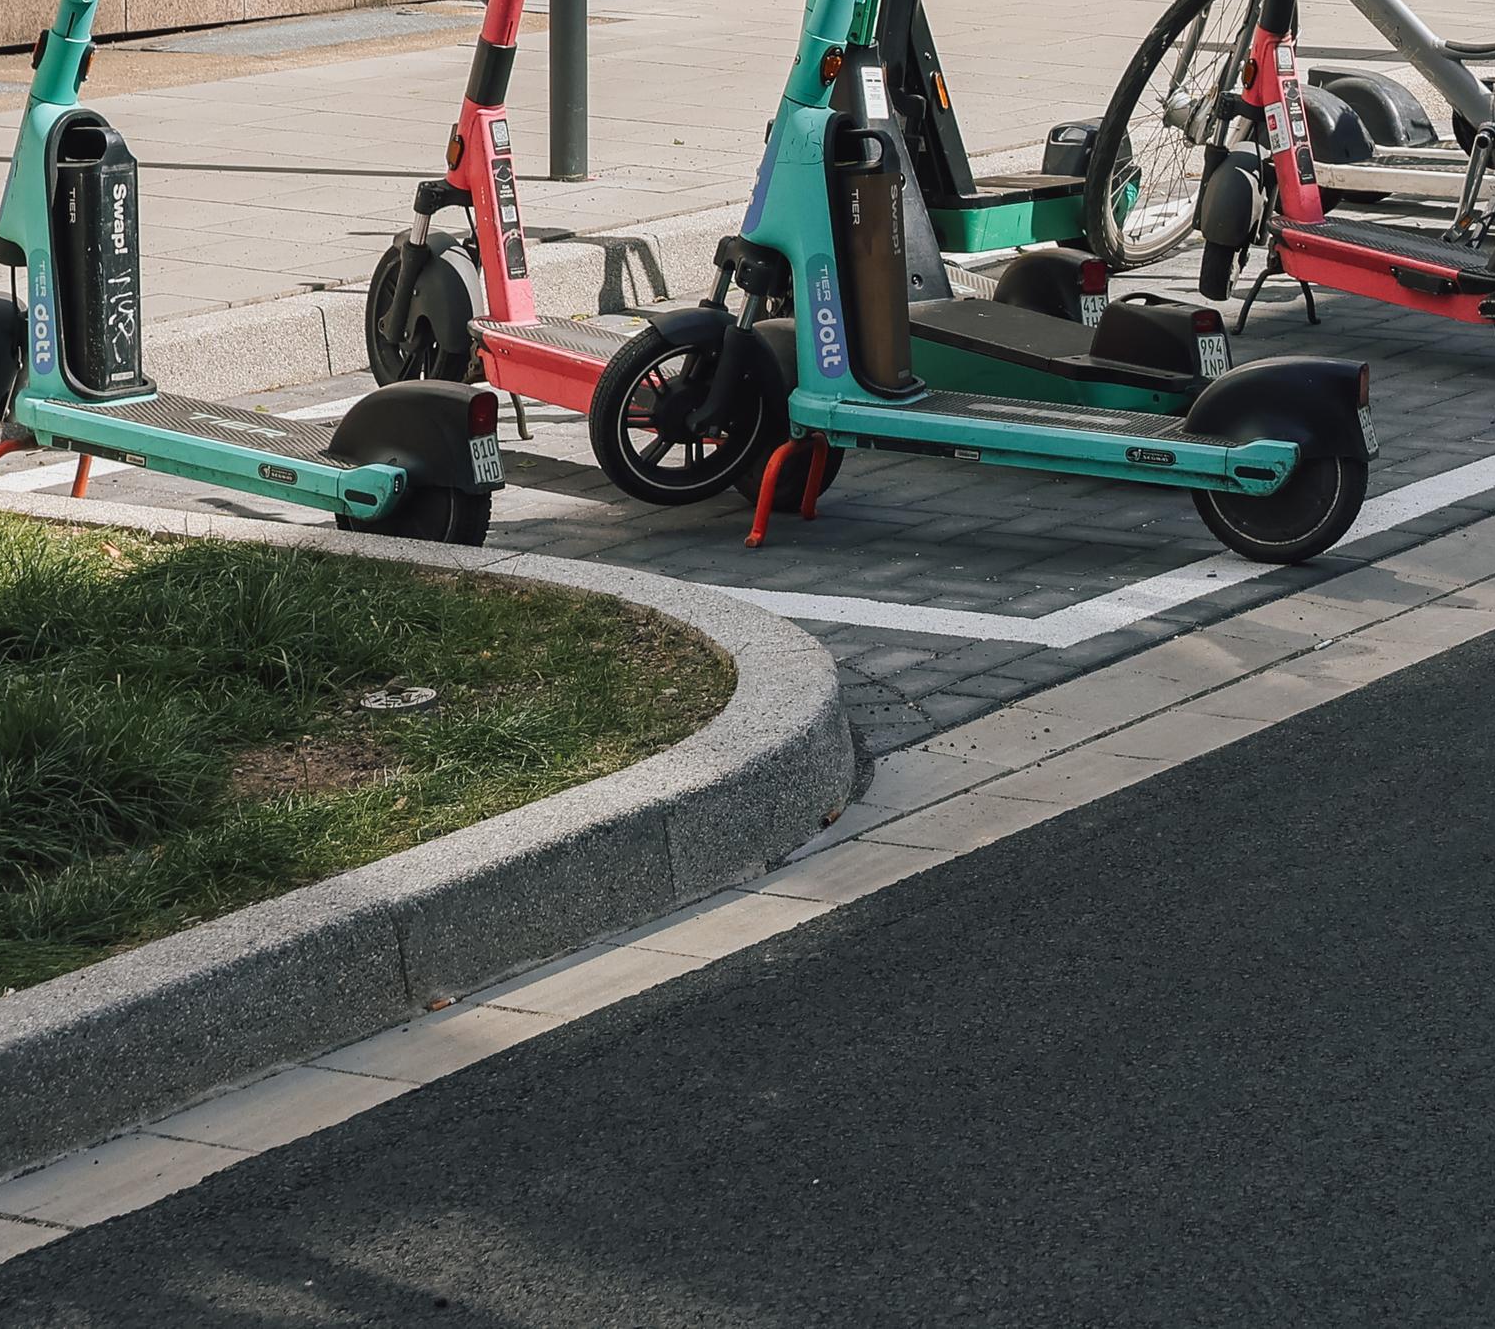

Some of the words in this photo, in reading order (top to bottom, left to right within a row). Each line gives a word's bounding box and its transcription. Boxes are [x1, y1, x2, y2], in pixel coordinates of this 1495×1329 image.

[68, 187, 76, 224] TIER
[110, 182, 128, 255] Swap!
[851, 188, 861, 226] TIER
[890, 184, 901, 256] Swap!
[39, 260, 47, 298] TIER
[820, 264, 831, 302] TIER
[1084, 296, 1106, 313] 413
[34, 303, 51, 365] dott
[817, 308, 842, 368] dott
[1200, 338, 1222, 356] 994
[1204, 358, 1225, 376] INP
[189, 411, 291, 441] TIER
[472, 437, 495, 460] 810
[477, 460, 500, 482] IHD
